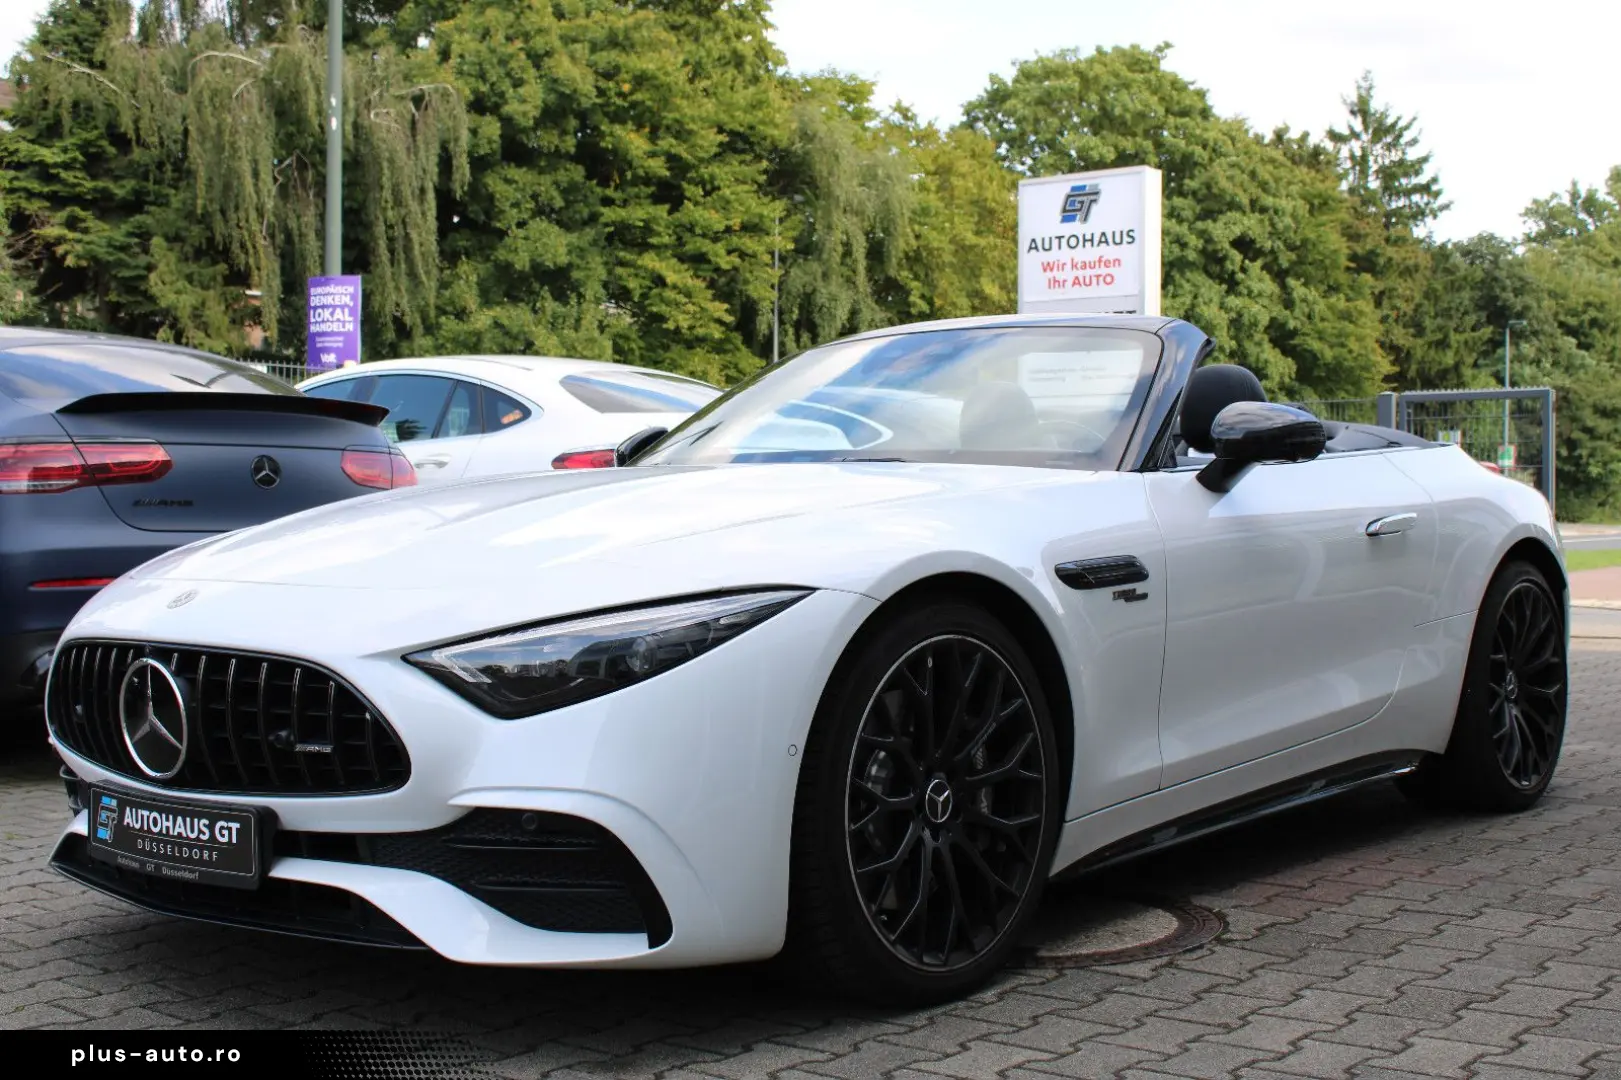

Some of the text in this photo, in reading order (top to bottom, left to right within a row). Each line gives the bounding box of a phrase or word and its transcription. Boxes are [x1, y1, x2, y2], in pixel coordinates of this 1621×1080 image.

[1027, 229, 1136, 254] AUTOHAUS
[1041, 256, 1122, 273] Wir kaufen
[1047, 273, 1115, 290] Ihr AUTO
[310, 295, 354, 307] DENKEN,
[310, 308, 353, 322] LOKAL
[310, 322, 353, 333] HANDELN
[123, 806, 209, 841] AUTOHAUS
[215, 820, 240, 844] GT
[137, 838, 218, 862] DÜSSELDORF
[146, 862, 156, 872] GT
